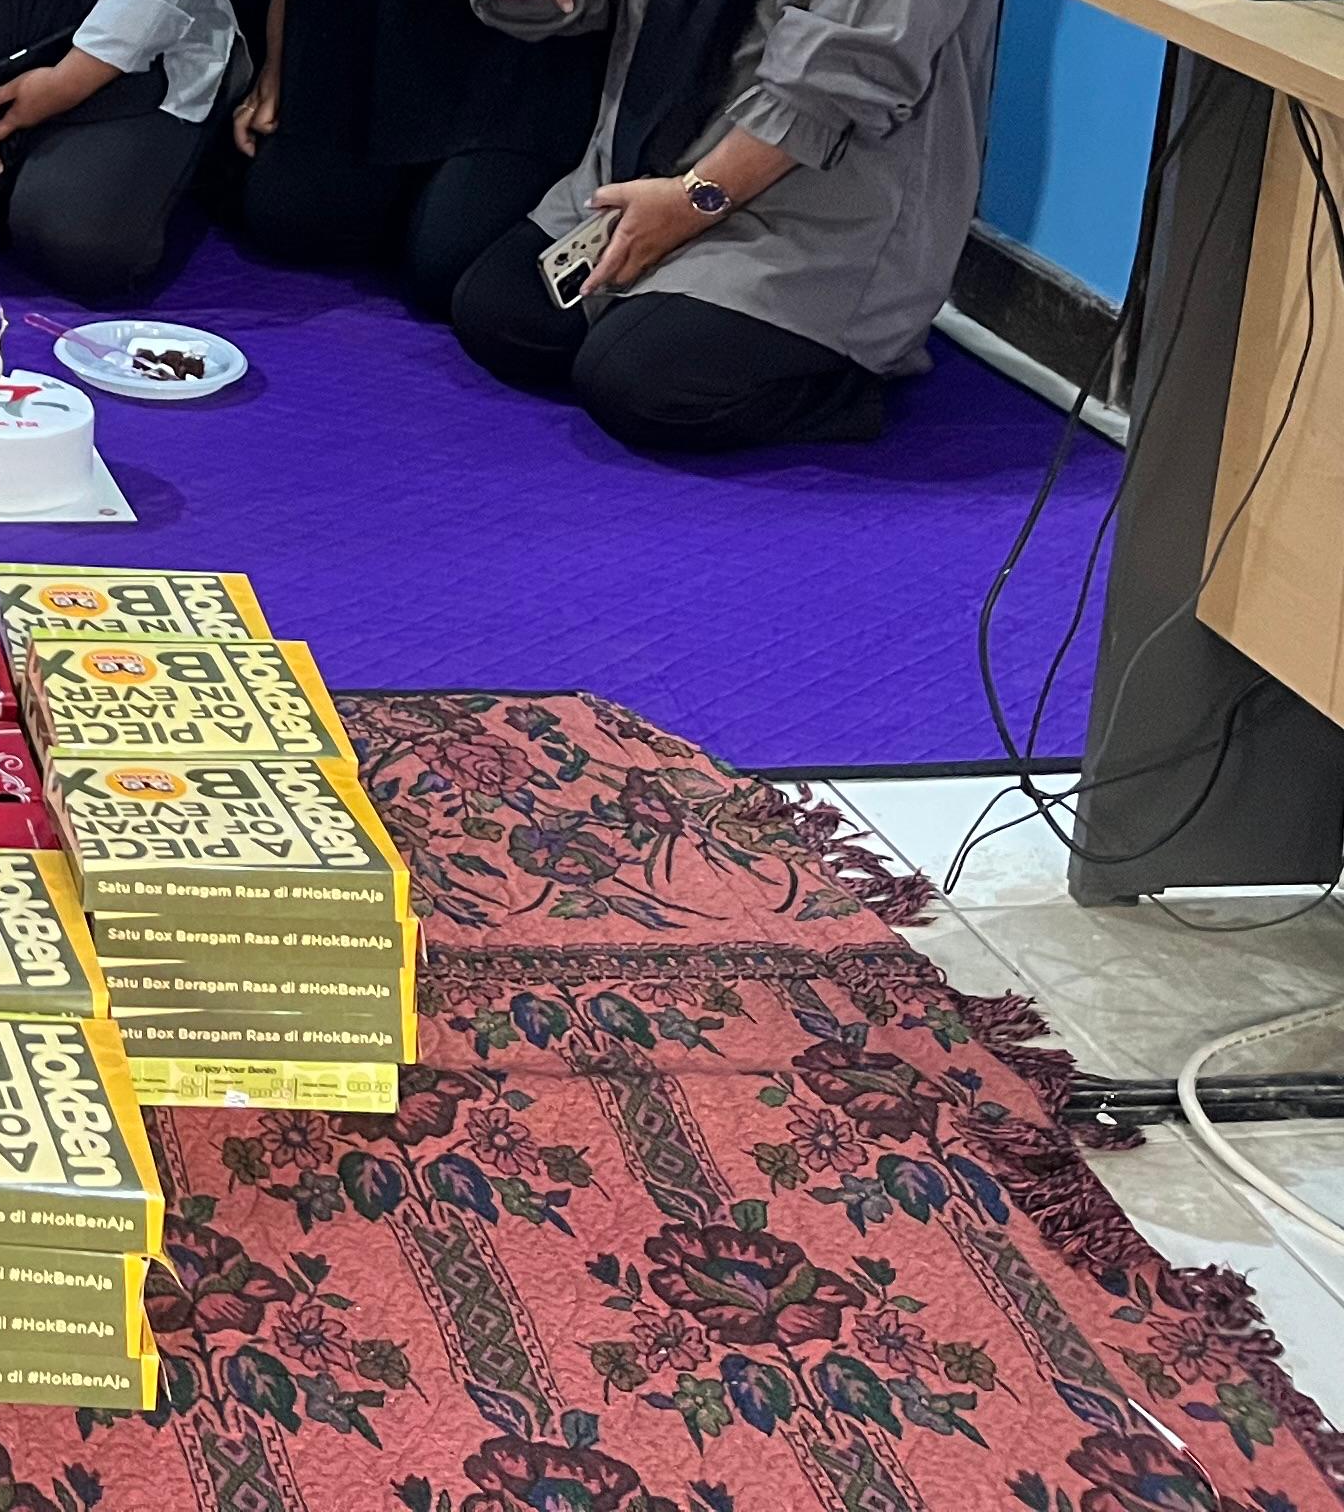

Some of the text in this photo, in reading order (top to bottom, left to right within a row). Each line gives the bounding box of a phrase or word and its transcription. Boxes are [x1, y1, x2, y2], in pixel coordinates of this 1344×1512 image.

[138, 618, 182, 633] IN
[193, 687, 237, 702] IN
[225, 644, 323, 753] HokBen
[190, 704, 246, 719] OF
[56, 721, 253, 744] A PIECE
[223, 802, 274, 818] IN
[260, 761, 371, 866] HokBen
[224, 820, 284, 836] OF
[81, 837, 293, 861] A PIECE
[98, 881, 384, 903] Satu Box Beragam Rasa di #HokBenAja
[107, 928, 393, 950] Satu Box Beragam Rasa di #HokBenAja
[106, 976, 390, 998] Satu Box Beragam Rasa di #HokBenAja
[120, 1028, 393, 1048] atu Box Beragam Rasa di #HokBenAja
[18, 1023, 123, 1188] HokBen
[10, 1208, 26, 1224] di
[31, 1211, 135, 1232] #HokBenAja
[9, 1266, 113, 1290] #HokBenAja
[12, 1316, 115, 1337] #HokBenAja
[7, 1368, 23, 1384] di
[28, 1370, 130, 1390] #HokBenAja
